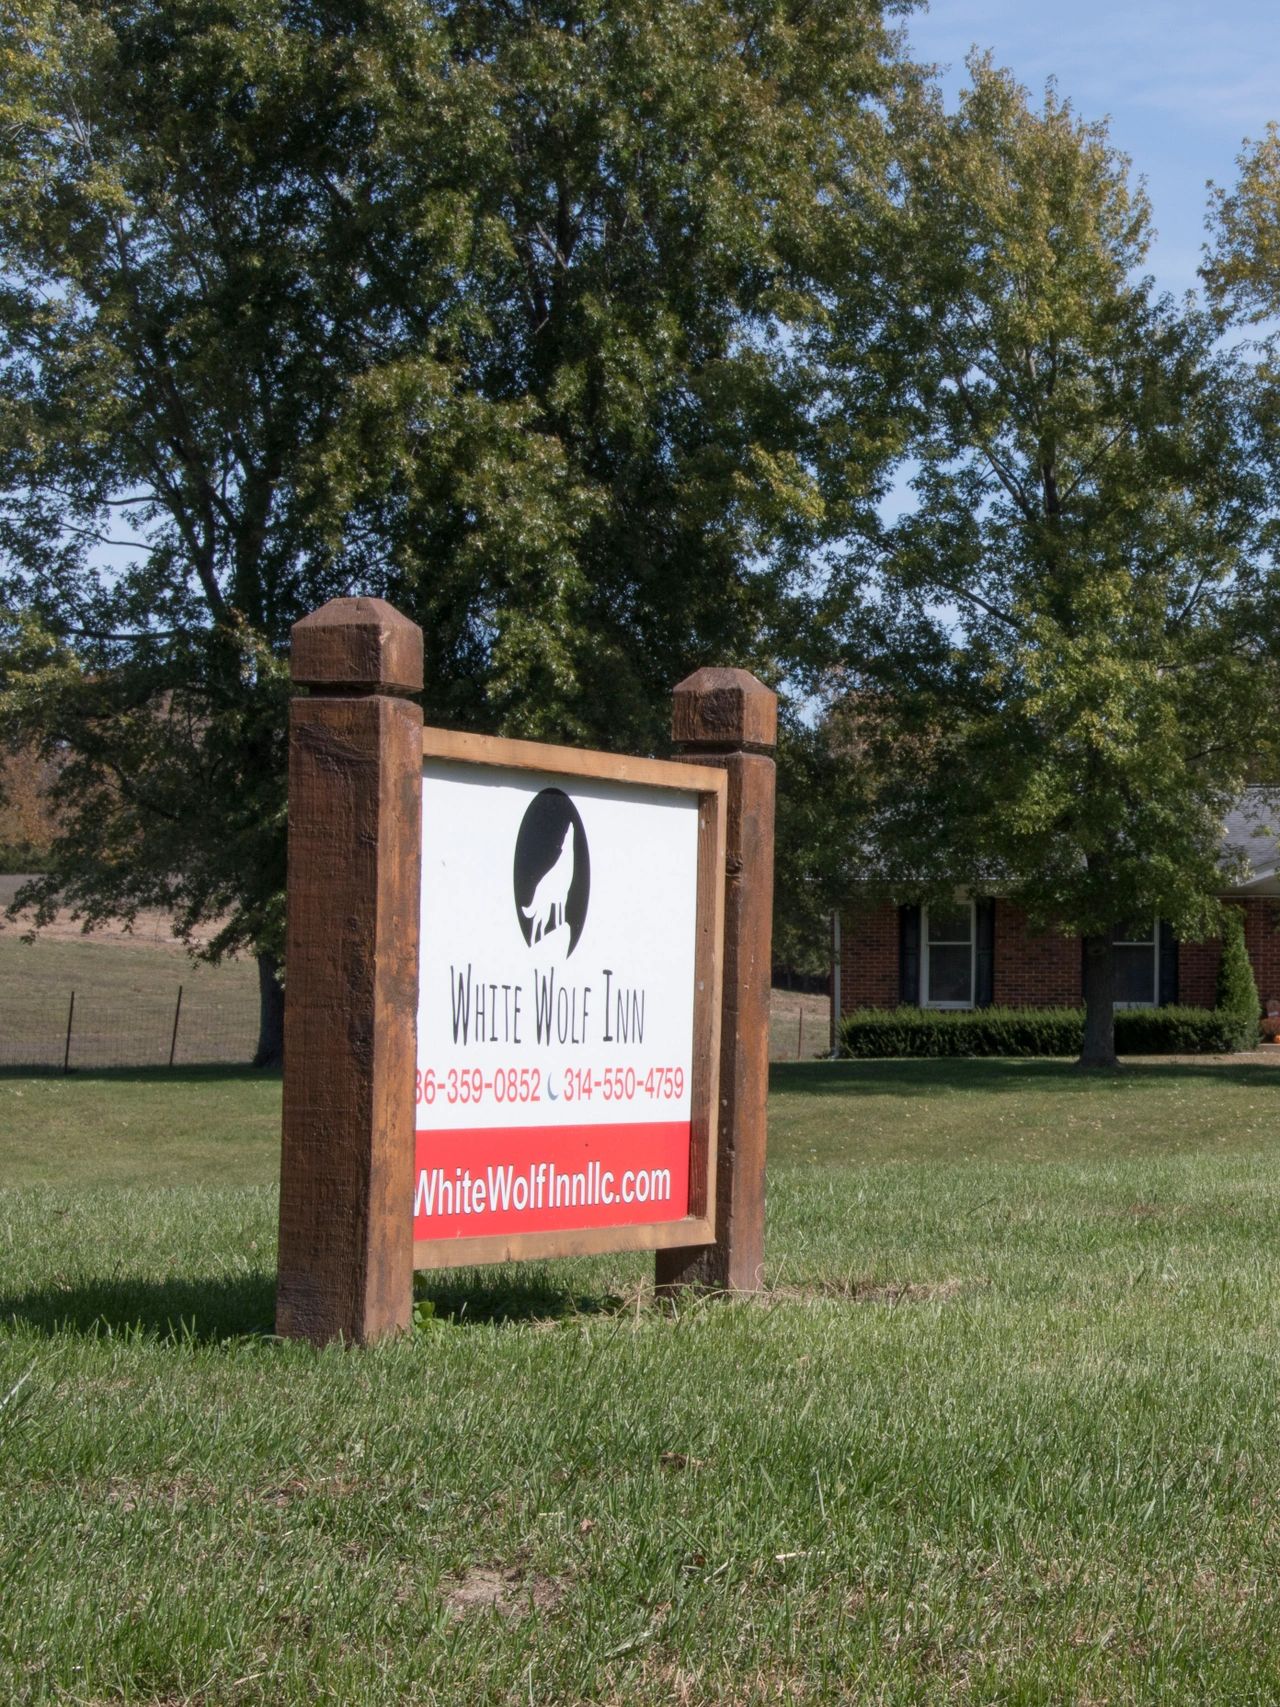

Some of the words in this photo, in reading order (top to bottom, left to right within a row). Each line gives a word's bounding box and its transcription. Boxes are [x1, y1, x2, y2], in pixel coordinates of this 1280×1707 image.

[450, 963, 522, 1046] WHITE
[534, 966, 592, 1047] WOLF
[602, 969, 645, 1045] INN
[563, 1067, 684, 1101] 314-550-4759
